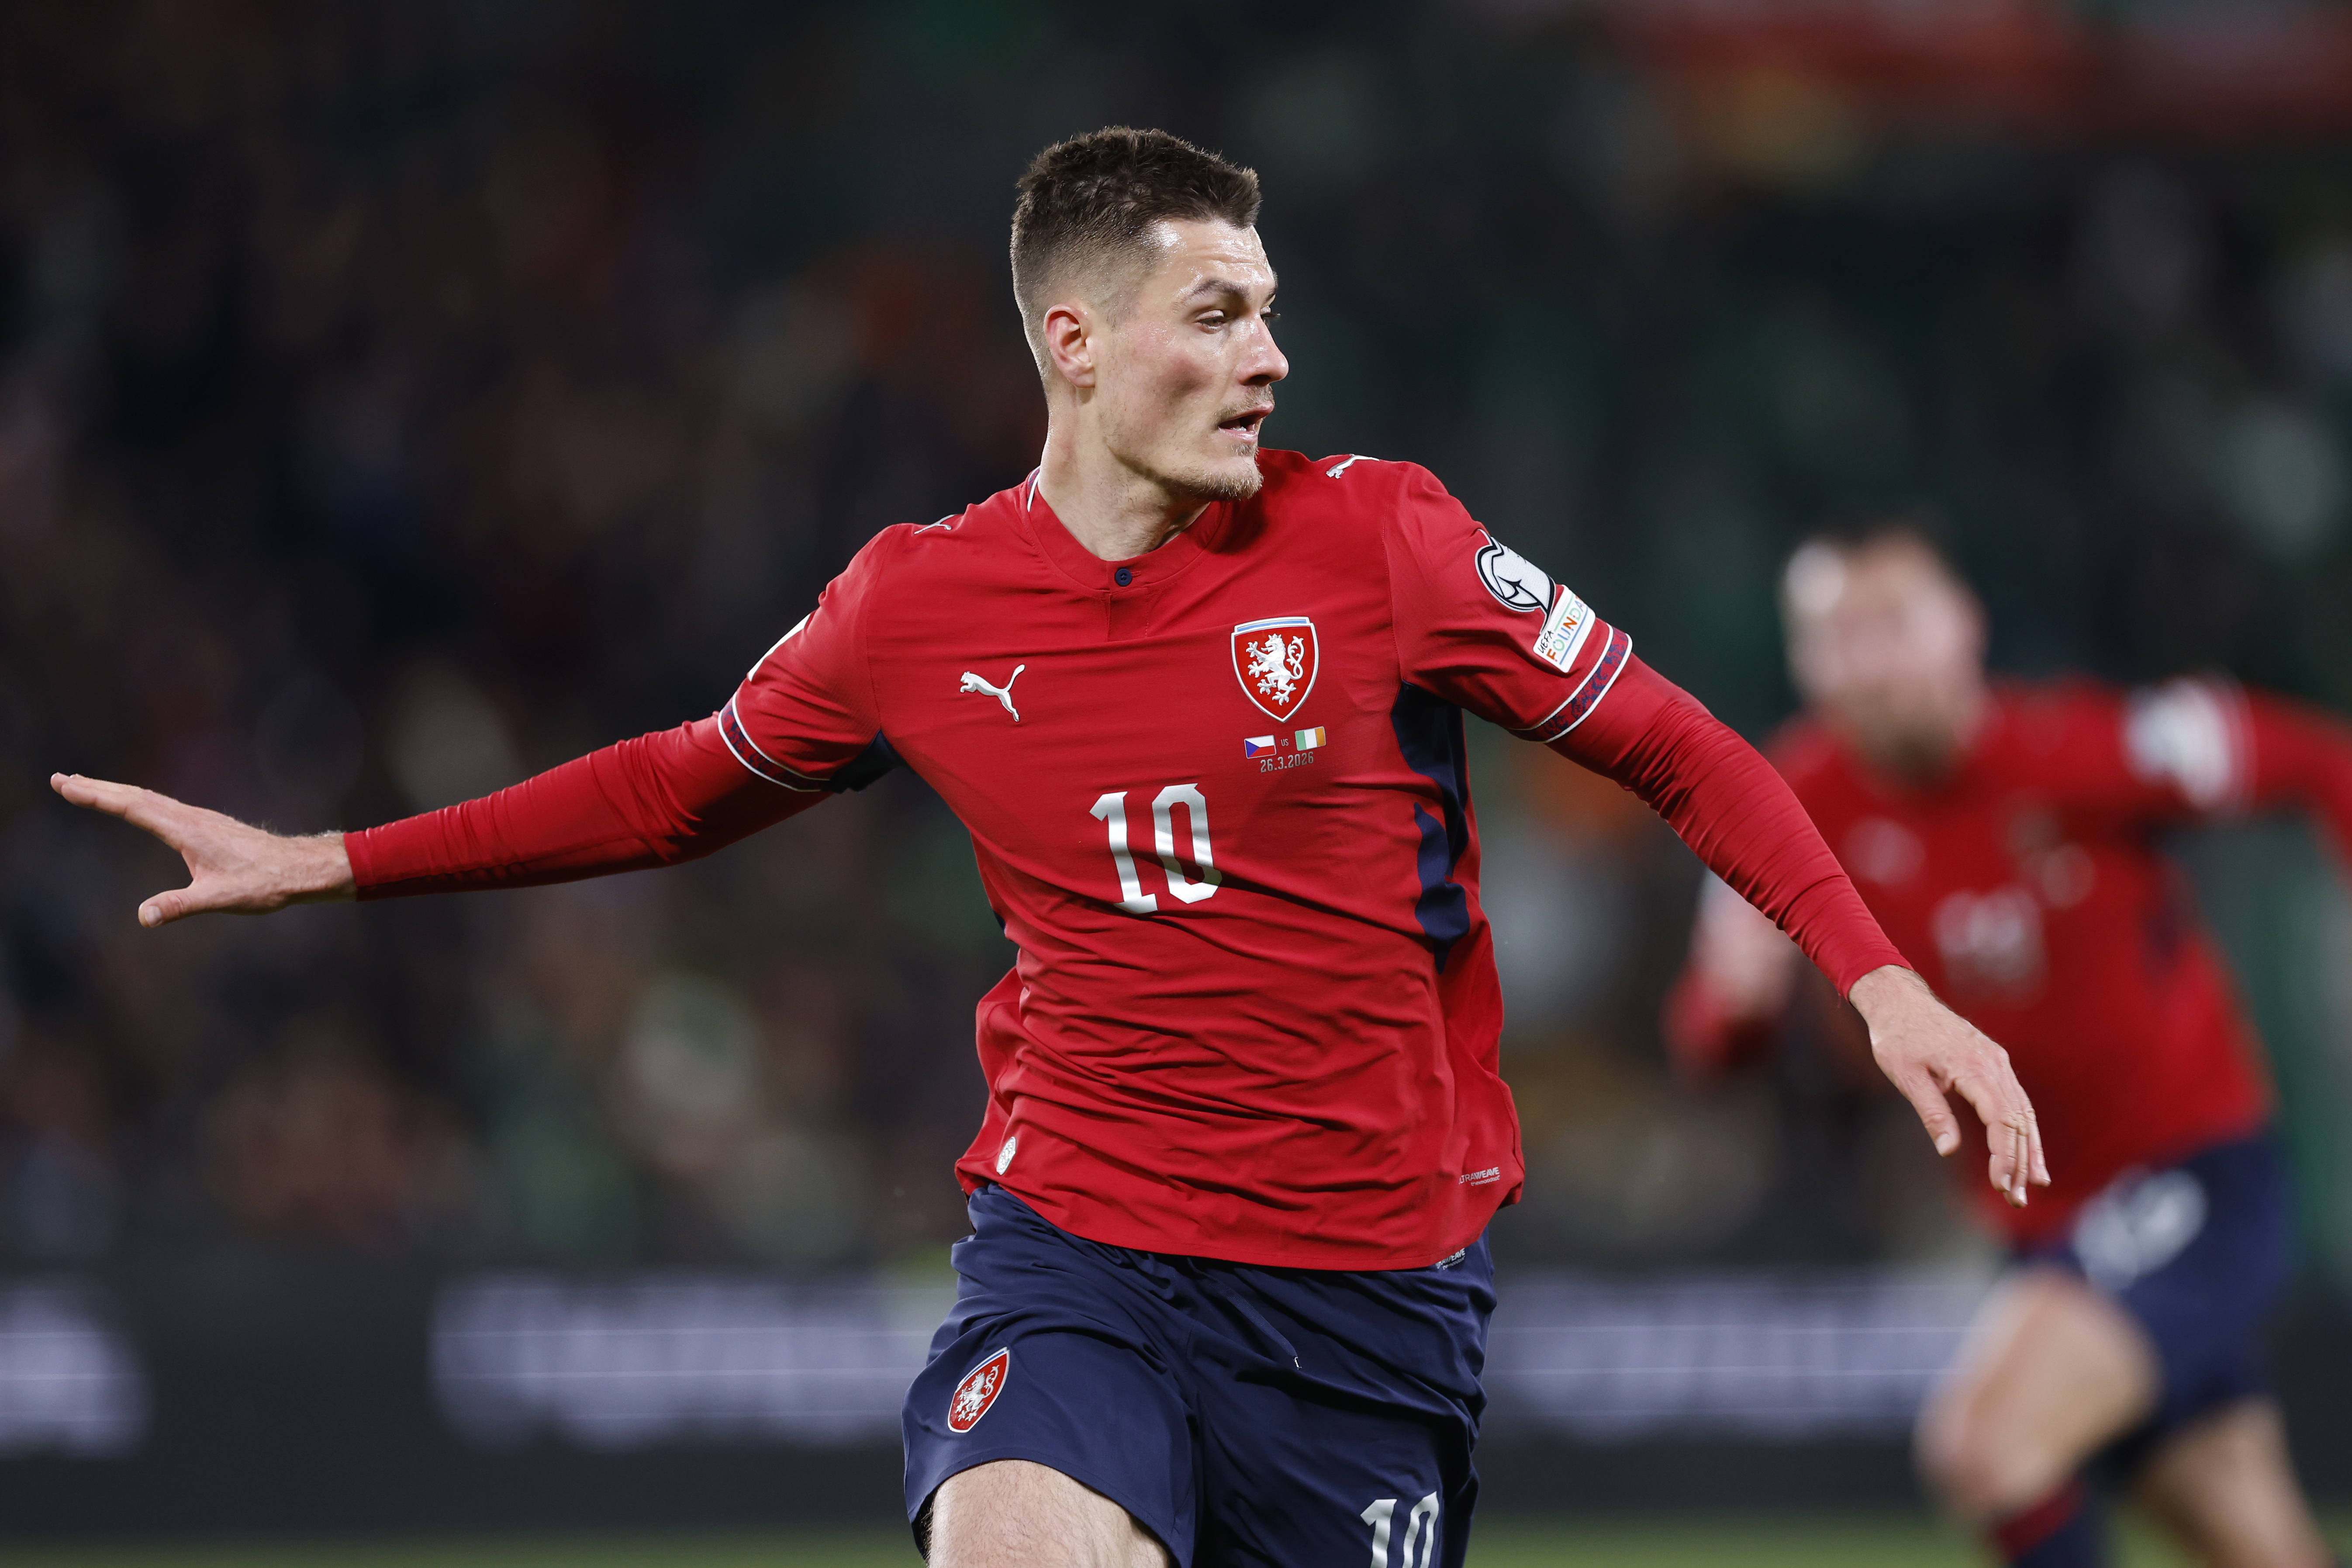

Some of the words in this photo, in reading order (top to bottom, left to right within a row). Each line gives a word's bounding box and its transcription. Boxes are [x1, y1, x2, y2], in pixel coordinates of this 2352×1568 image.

[1538, 630, 1554, 653] UEFA
[1547, 594, 1585, 662] FOUNDA
[1260, 751, 1314, 773] 26.3.2026
[1089, 783, 1223, 914] 10
[1360, 1491, 1440, 1568] 10
